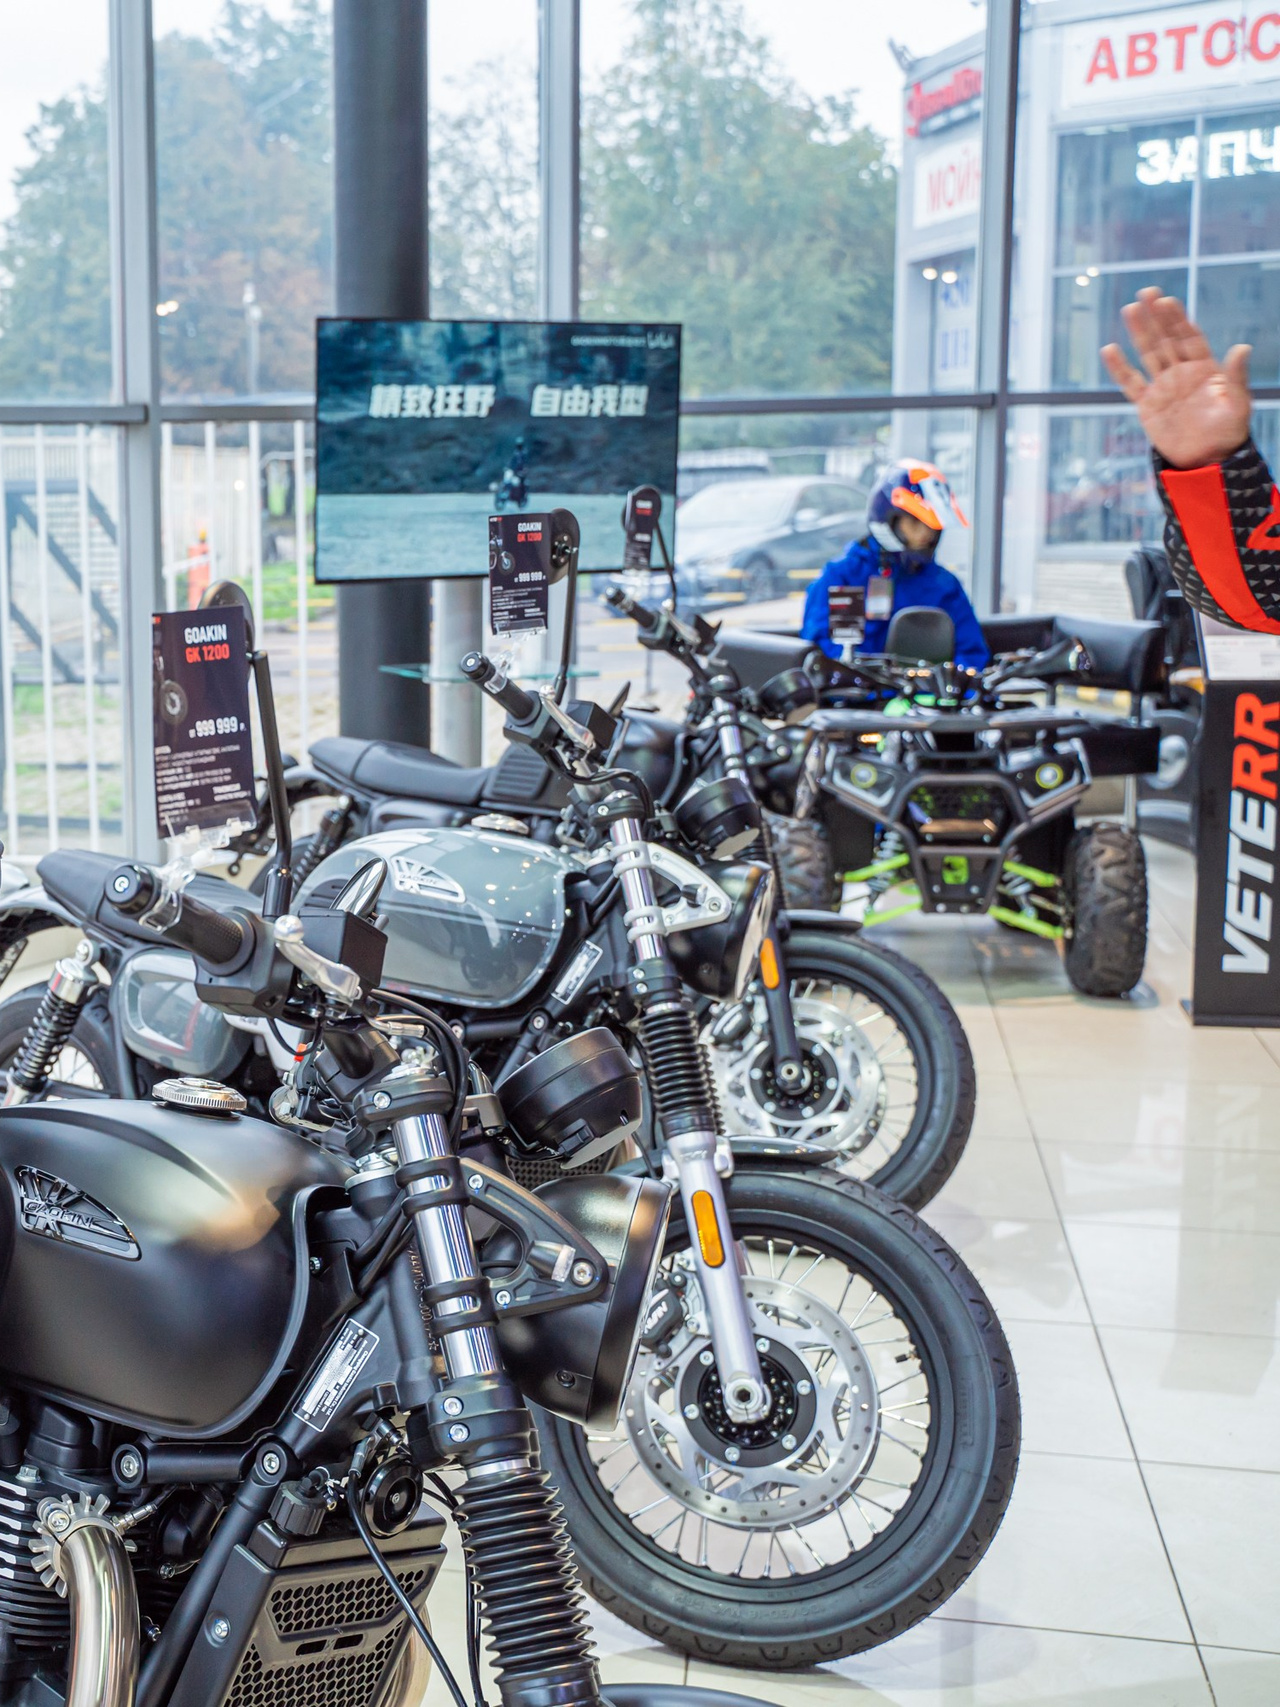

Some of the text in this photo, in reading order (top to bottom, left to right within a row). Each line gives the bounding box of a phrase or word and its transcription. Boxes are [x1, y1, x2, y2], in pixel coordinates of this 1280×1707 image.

[1086, 13, 1280, 84] АВТОС
[184, 624, 227, 644] GOAKIN
[185, 643, 230, 663] GK 1200
[195, 719, 216, 737] 999
[216, 716, 238, 735] 999
[26, 1201, 94, 1227] GAOKIN
